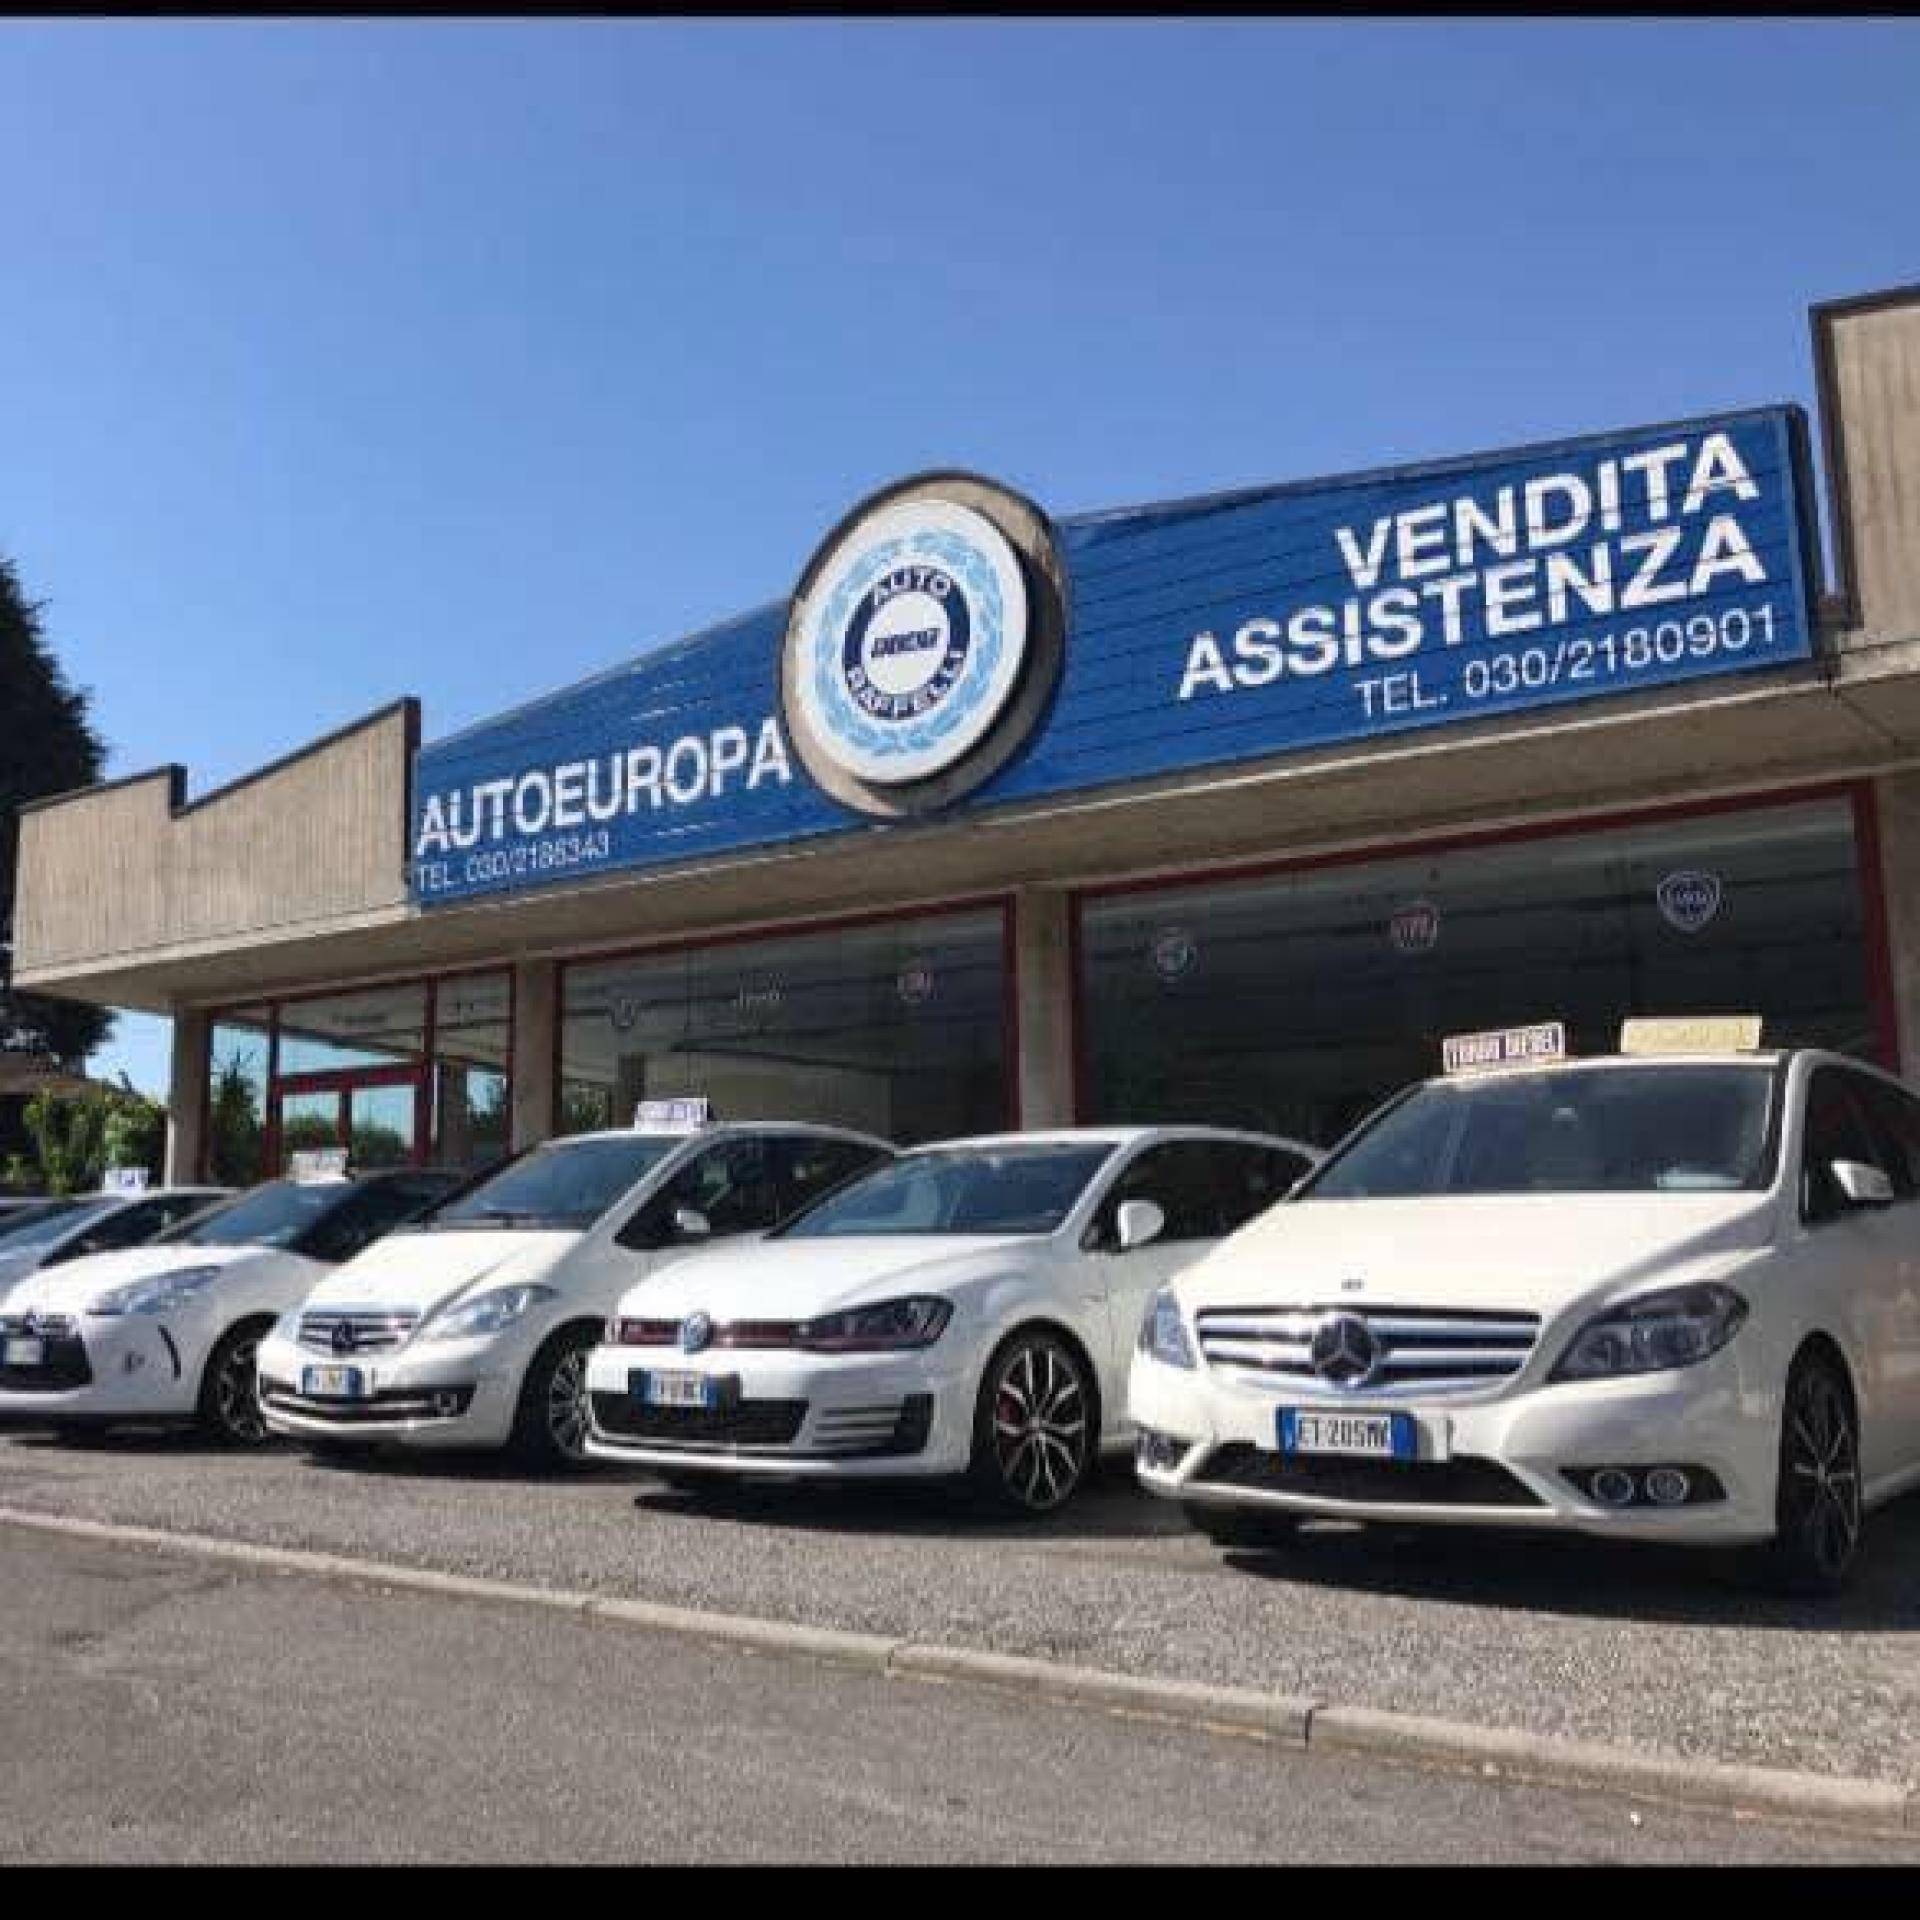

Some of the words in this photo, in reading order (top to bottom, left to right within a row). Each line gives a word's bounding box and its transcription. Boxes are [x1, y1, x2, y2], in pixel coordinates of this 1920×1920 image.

[1335, 431, 1760, 591] VENDITA
[872, 566, 952, 607] AUTO
[1178, 513, 1767, 700] ASSISTENZA
[1353, 670, 1448, 717] TEL.
[1464, 604, 1775, 698] 030/2180901
[415, 715, 793, 855] AUTOEUROPA
